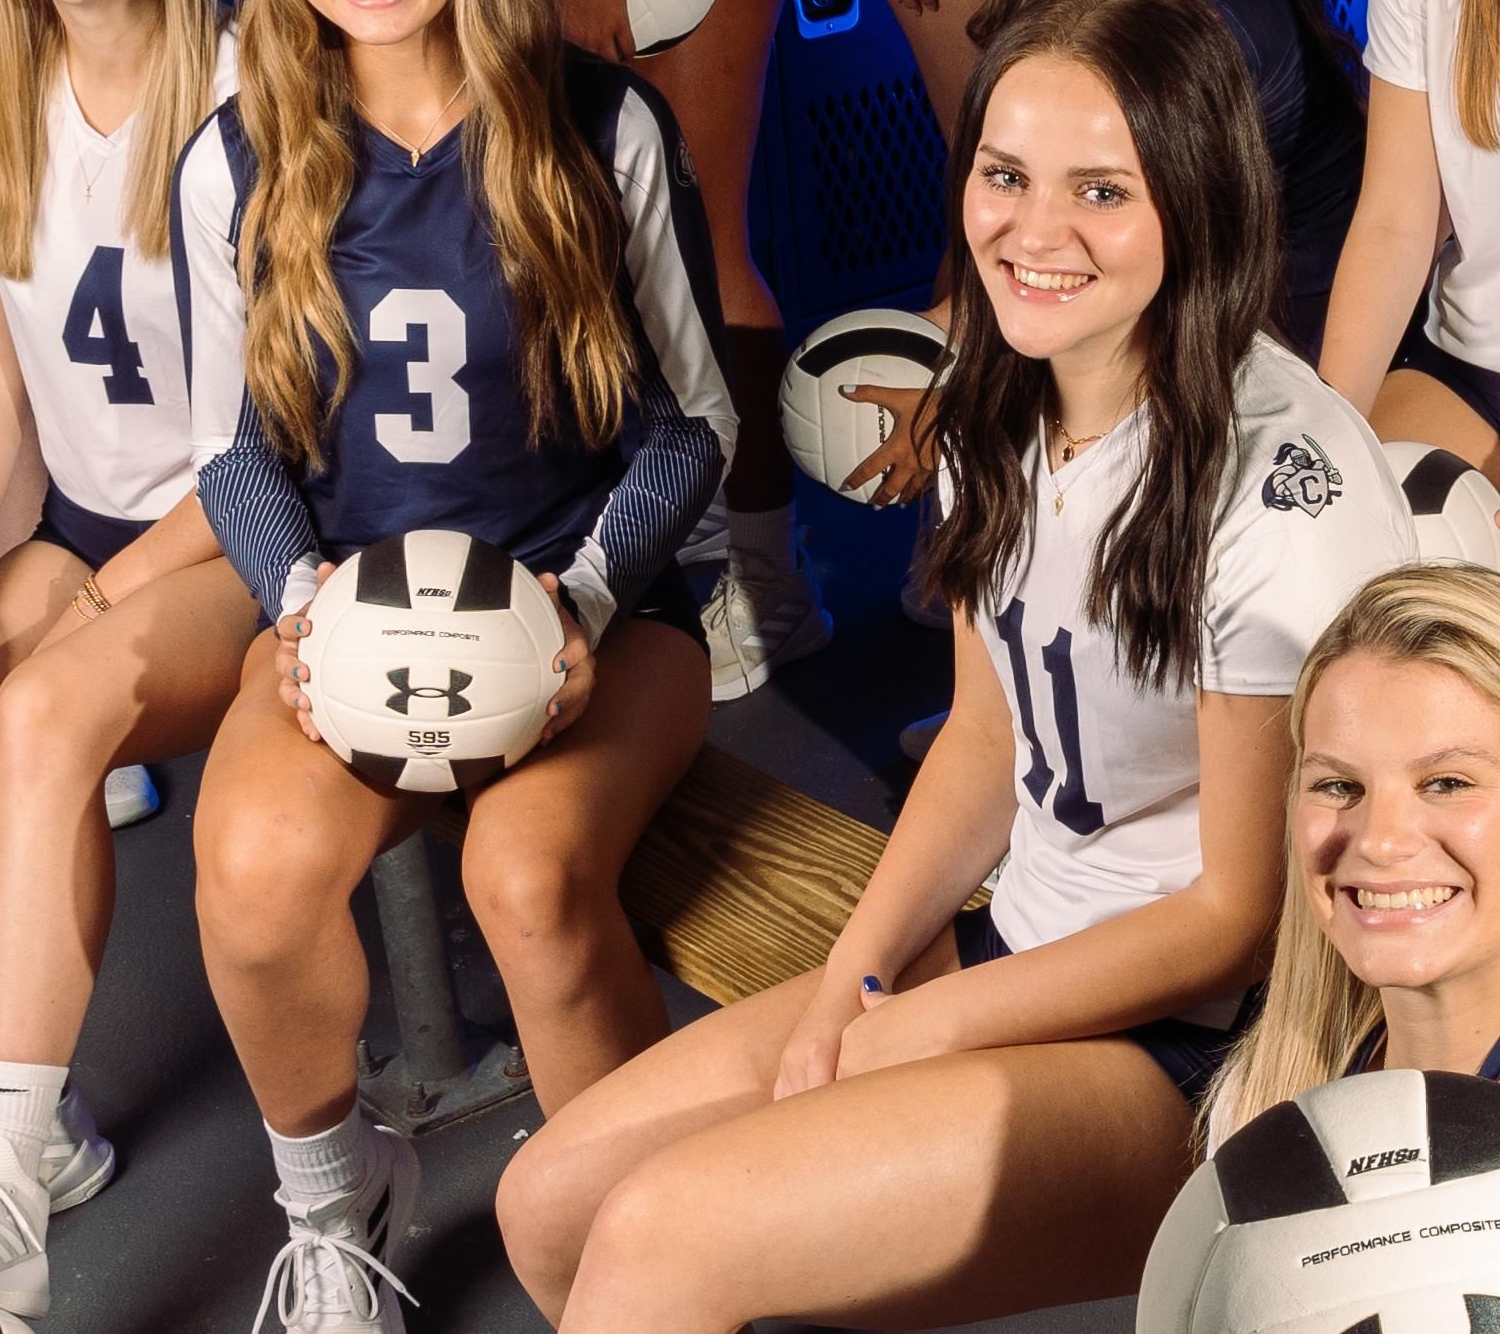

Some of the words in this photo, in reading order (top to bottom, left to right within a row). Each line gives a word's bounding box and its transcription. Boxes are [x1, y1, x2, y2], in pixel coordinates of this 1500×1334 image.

[61, 245, 156, 406] 4
[369, 288, 471, 464] 3
[408, 730, 450, 744] 595
[996, 597, 1106, 837] 11
[1302, 1230, 1412, 1267] PERFORMANCE
